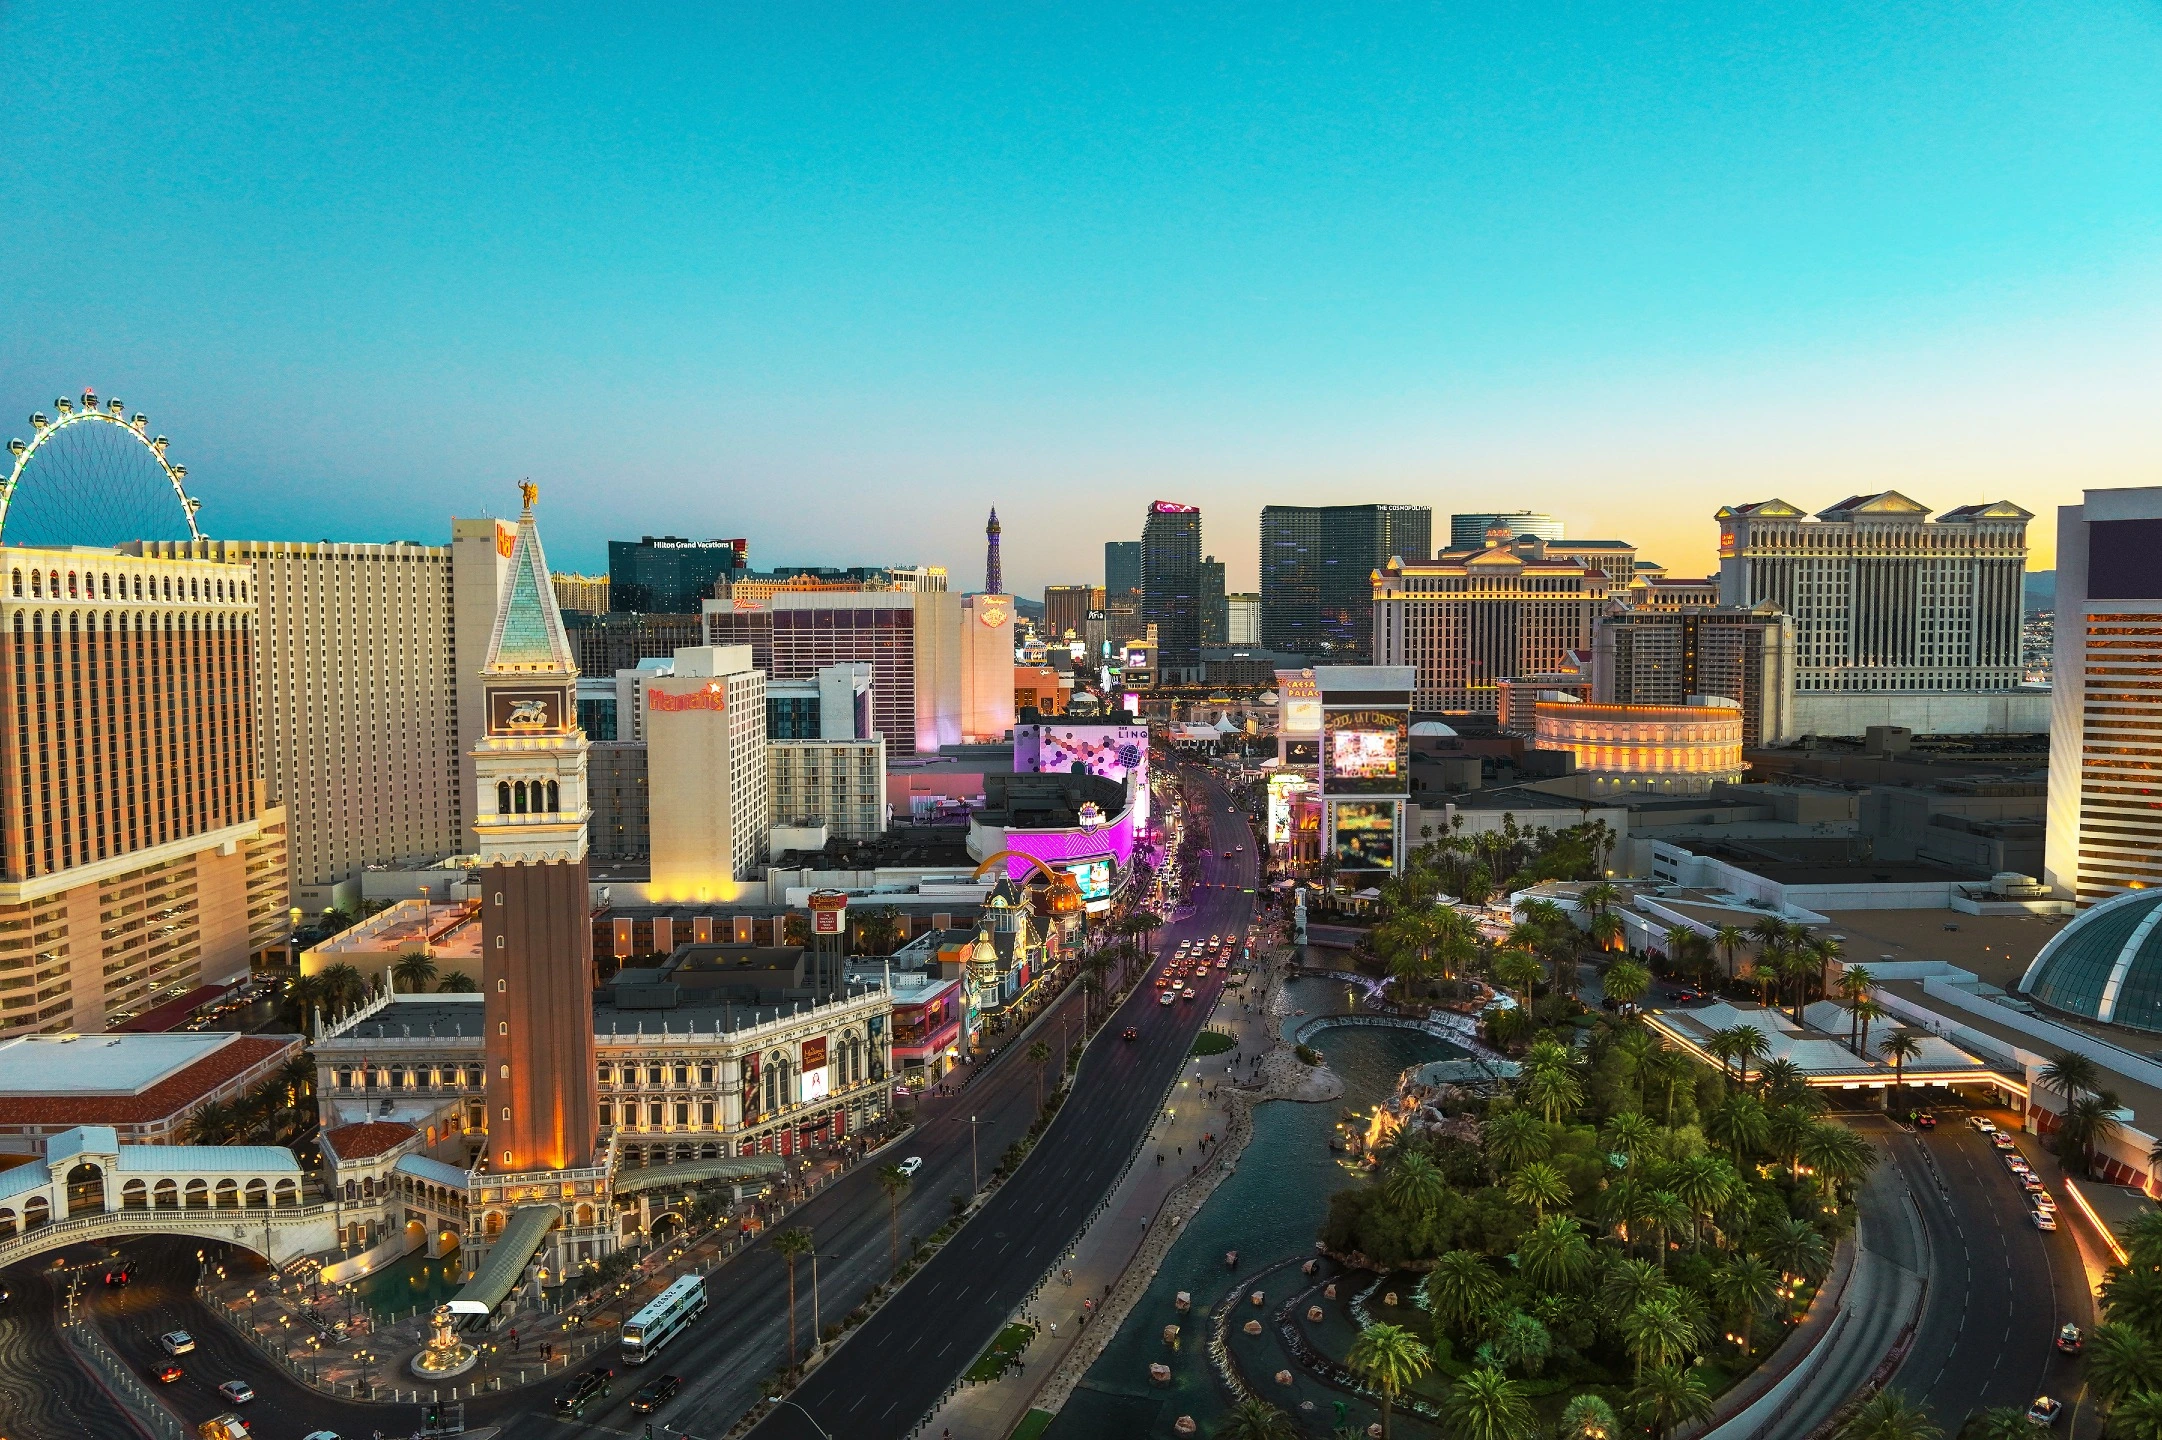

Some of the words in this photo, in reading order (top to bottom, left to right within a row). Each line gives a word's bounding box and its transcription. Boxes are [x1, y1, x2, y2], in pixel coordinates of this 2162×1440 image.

[653, 541, 675, 549] Hilton
[675, 541, 697, 549] Grand
[697, 541, 729, 549] Vacations
[1288, 689, 1321, 697] PALAC
[1118, 731, 1148, 739] LINQ
